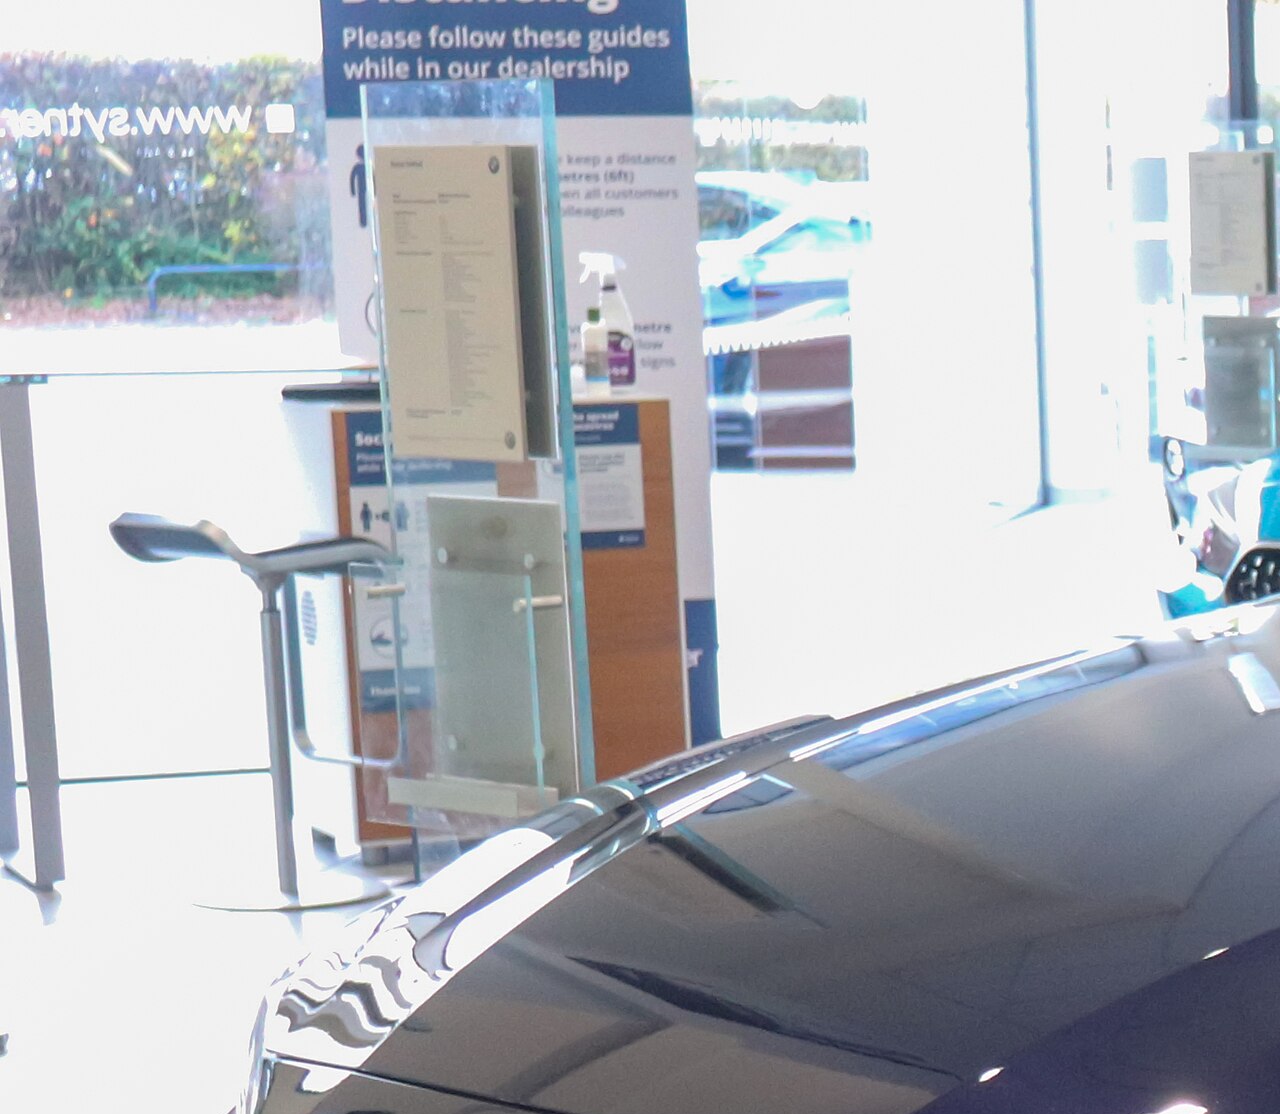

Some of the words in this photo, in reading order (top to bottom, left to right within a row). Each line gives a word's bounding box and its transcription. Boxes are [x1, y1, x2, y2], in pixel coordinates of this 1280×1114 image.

[342, 26, 422, 50] Please
[428, 25, 505, 49] follow
[512, 26, 582, 49] these
[588, 24, 671, 53] guides
[343, 56, 410, 80] while
[417, 56, 440, 79] in
[447, 60, 491, 80] our
[498, 55, 630, 84] dealership
[566, 153, 601, 167] keep
[617, 153, 677, 165] distance
[559, 171, 600, 182] etres
[604, 169, 634, 183] (6ft)
[604, 188, 679, 199] customers
